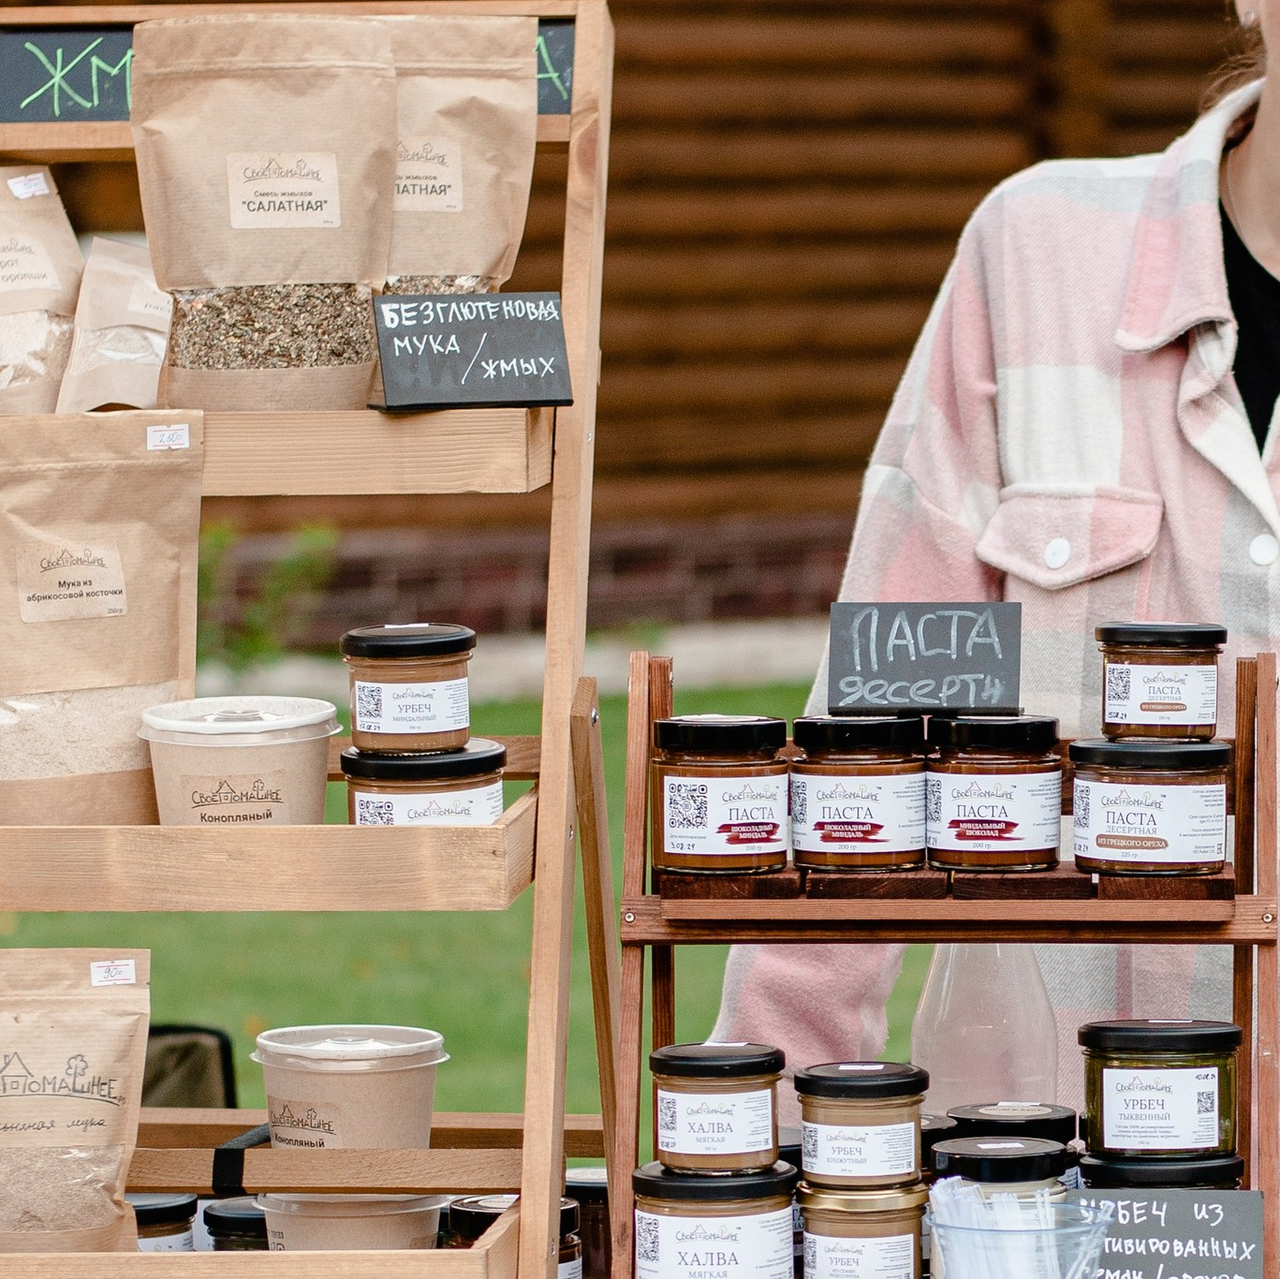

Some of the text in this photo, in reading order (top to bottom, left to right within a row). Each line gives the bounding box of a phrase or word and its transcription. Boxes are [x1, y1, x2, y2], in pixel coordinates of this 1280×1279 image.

[242, 200, 328, 212] "САЛАТНАЯ"
[381, 299, 560, 329] БЕЗГЛЮТЕНОВАЯ
[393, 334, 460, 357] МУКА
[481, 356, 555, 380] ЖМЫХ
[58, 579, 93, 590] Мука из
[26, 588, 124, 603] абрикосовой косточки
[852, 606, 1003, 672] ПАСТА
[1148, 686, 1181, 695] ПАСТА
[398, 704, 432, 714] УРБЕЧ
[392, 715, 437, 723] МИНДАЛЬНЫЙ
[200, 808, 273, 823] Конопляный
[728, 807, 775, 821] ПАСТА
[822, 806, 874, 820] ПАСТА
[957, 804, 1009, 818] ПАСТА
[1106, 811, 1157, 826] ПАСТА
[1106, 825, 1158, 835] ДЕСЕРТНАЯ
[1123, 1099, 1165, 1110] УРБЕЧ
[1119, 1112, 1171, 1121] ТЫКВЕННЫЙ
[688, 1122, 734, 1134] ХАЛВА
[274, 1132, 325, 1148] Конопляный
[831, 1146, 862, 1156] УРБЕЧ
[1194, 1203, 1224, 1227] ИЗ
[678, 1251, 739, 1266] ХАЛВА
[829, 1257, 859, 1266] УРБЕЧ
[688, 1270, 728, 1279] МЯГКАЯ
